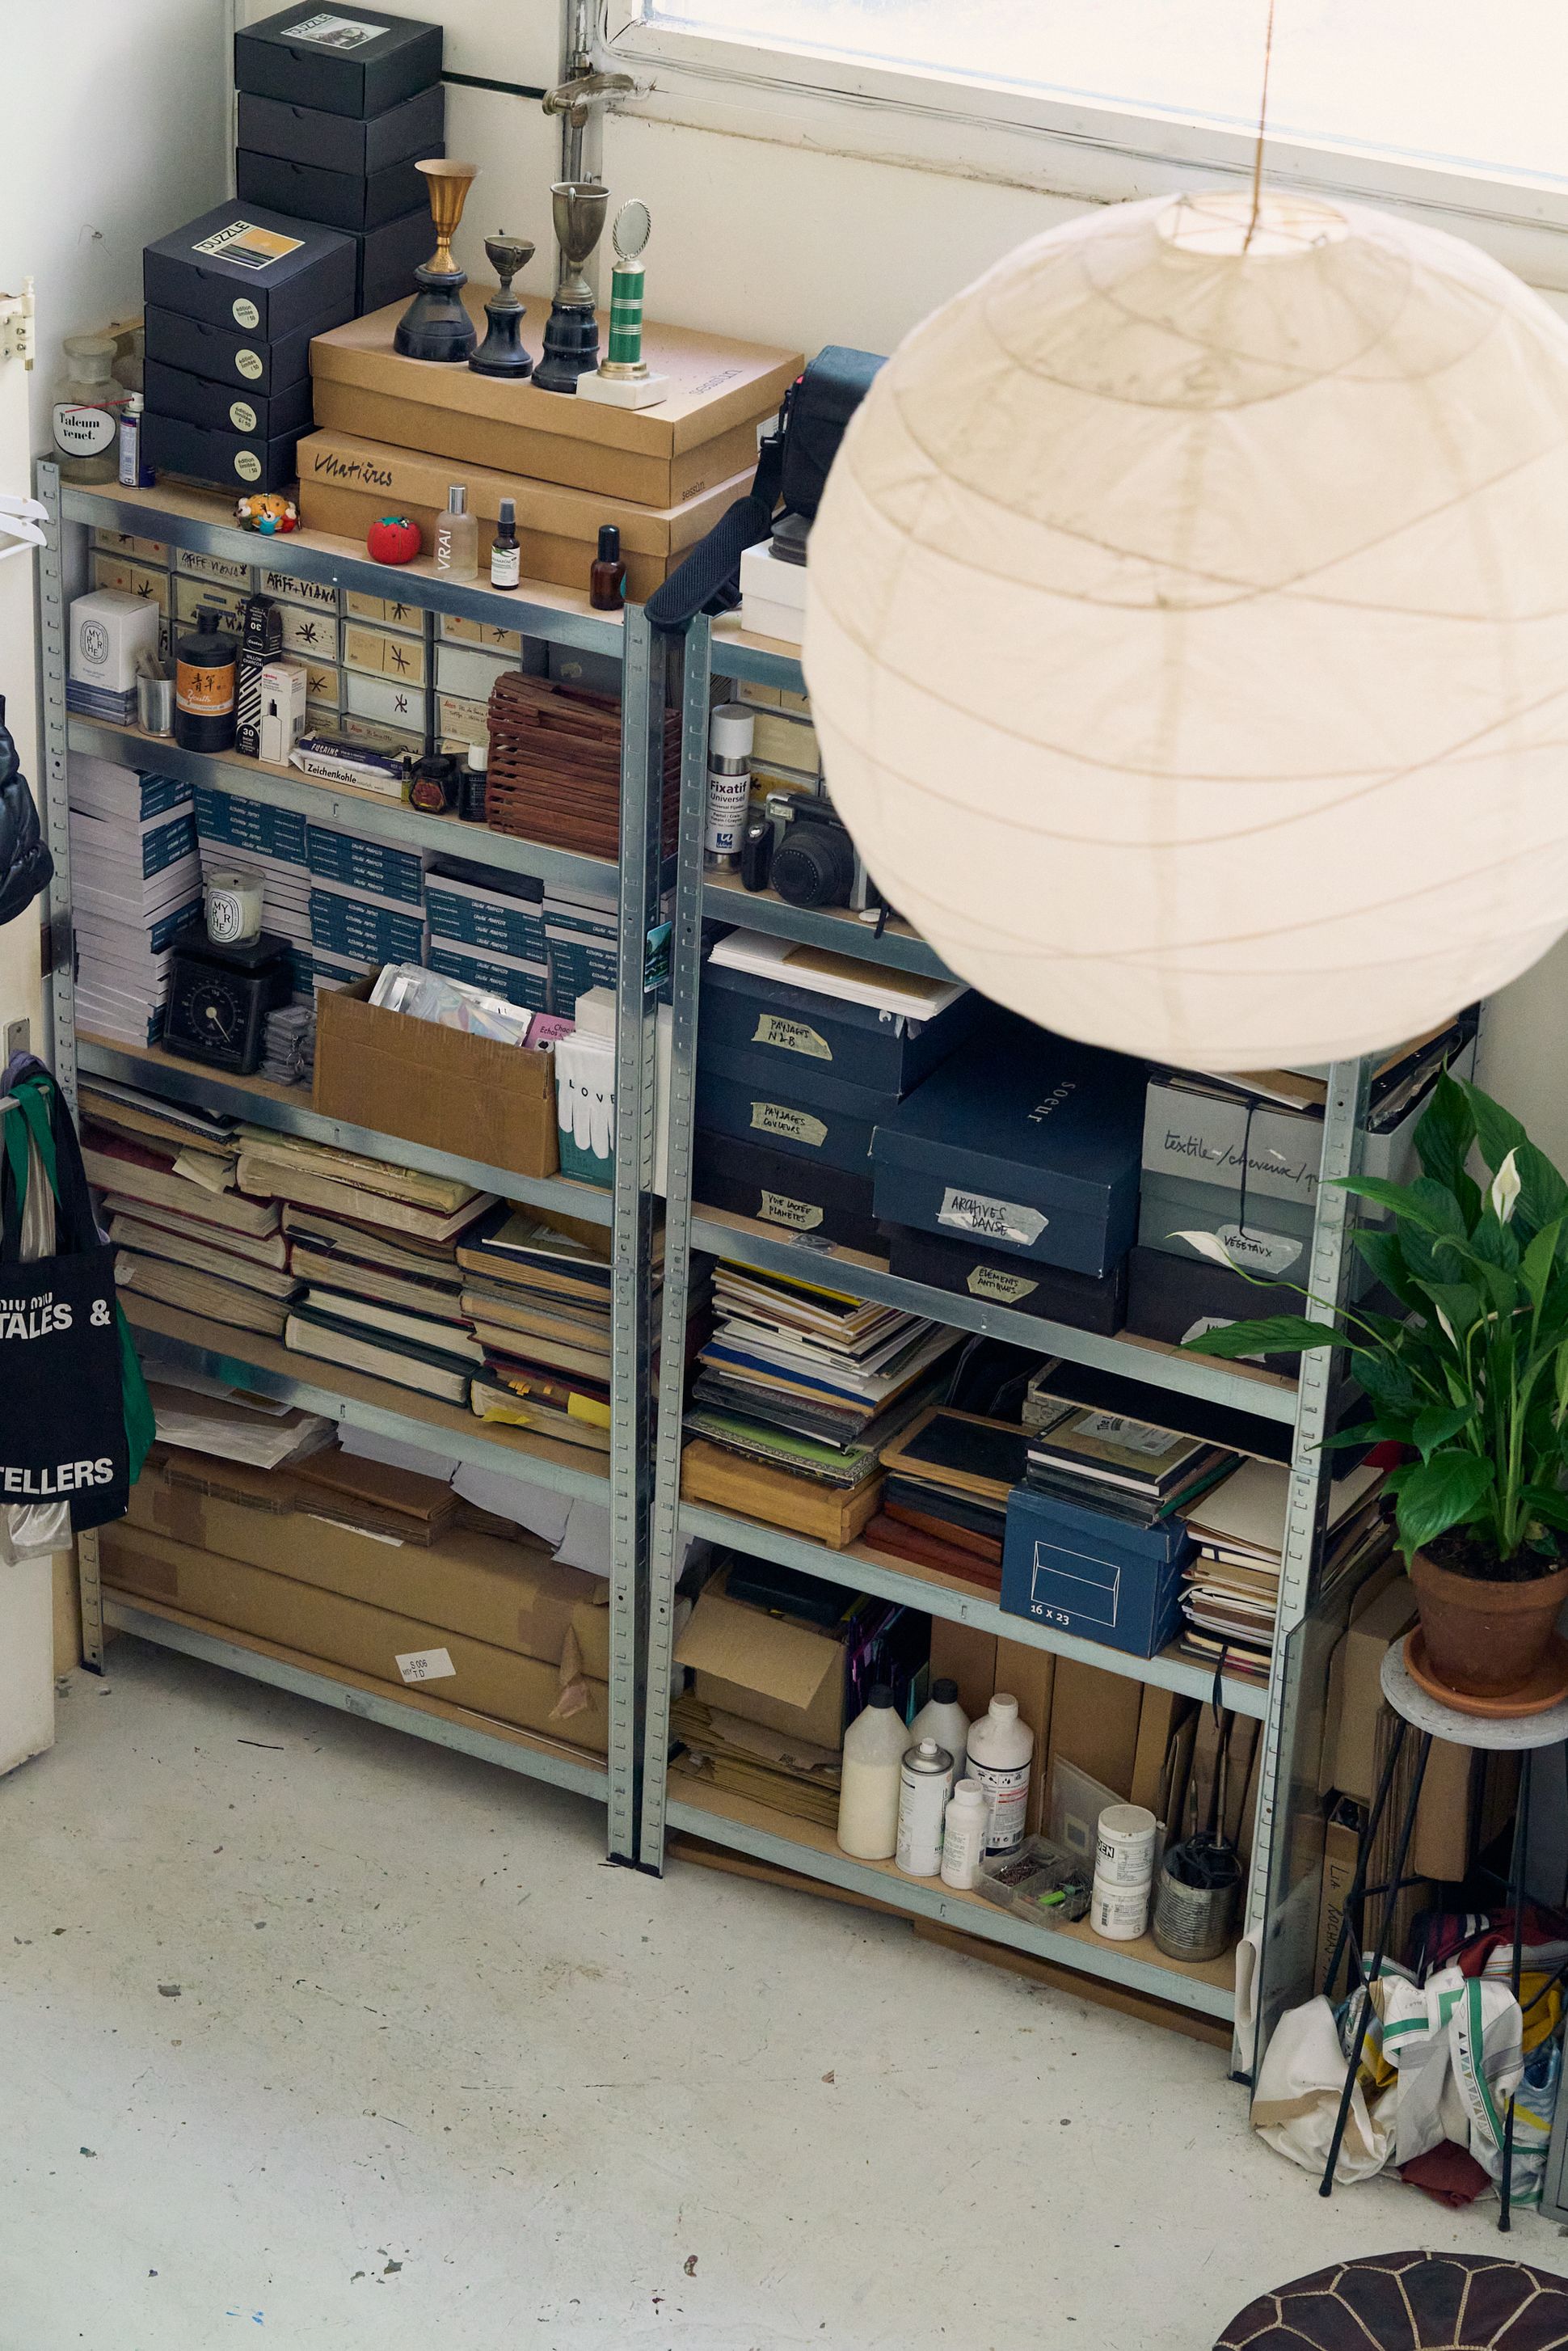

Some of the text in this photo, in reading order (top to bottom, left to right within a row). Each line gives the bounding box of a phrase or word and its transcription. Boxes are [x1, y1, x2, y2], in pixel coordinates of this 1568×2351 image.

[284, 14, 334, 34] PUZZLE
[196, 222, 251, 249] PUZZLE
[59, 412, 100, 428] Talcum
[63, 429, 95, 441] venet.
[314, 453, 393, 487] Matières
[437, 529, 452, 571] VRAI
[246, 653, 263, 662] WILLOW
[242, 728, 255, 737] 30
[310, 743, 339, 757] FUSAINS
[307, 763, 357, 784] Zeichenkohle
[710, 779, 748, 794] Fixatif
[710, 793, 745, 803] Universel
[486, 905, 504, 914] MANIFESTO
[487, 917, 506, 926] MANIFESTO
[488, 929, 508, 938] MANIFESTO
[490, 941, 508, 950] MANIFESTO
[539, 1025, 558, 1036] Echos
[569, 1078, 615, 1104] LOVE
[1027, 1081, 1076, 1123] soeur
[765, 1104, 806, 1126] PAYSAGES
[763, 1119, 801, 1135] COULEURS
[972, 1215, 1015, 1237] DANSE
[89, 1298, 112, 1327] &
[1031, 1604, 1070, 1626] 16 x 23
[410, 1661, 415, 1669] S
[419, 1669, 425, 1678] D
